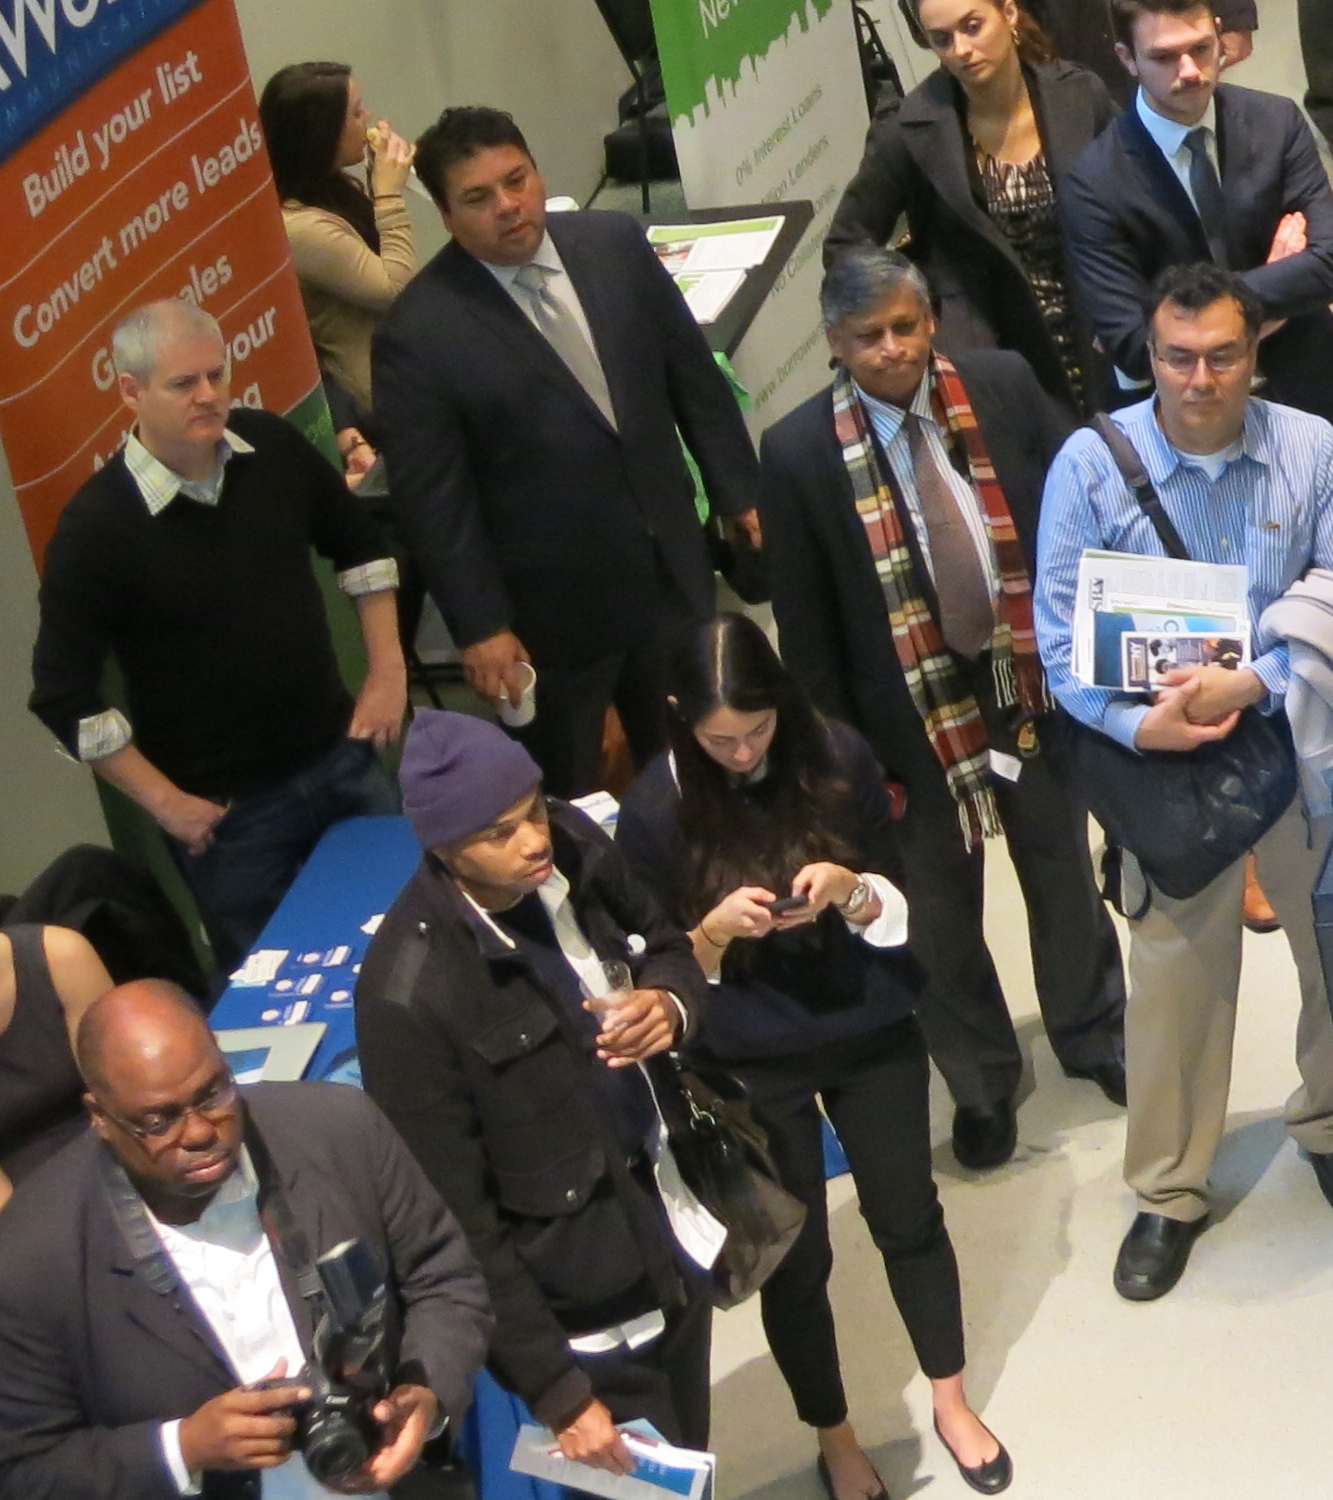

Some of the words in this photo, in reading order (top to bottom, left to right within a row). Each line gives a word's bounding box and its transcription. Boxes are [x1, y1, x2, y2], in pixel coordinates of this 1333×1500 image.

[23, 130, 90, 218] Build
[92, 88, 152, 170] your
[156, 50, 203, 105] list
[13, 236, 117, 348] Convert
[119, 180, 189, 256] more
[191, 118, 262, 194] leads
[178, 255, 233, 306] ales
